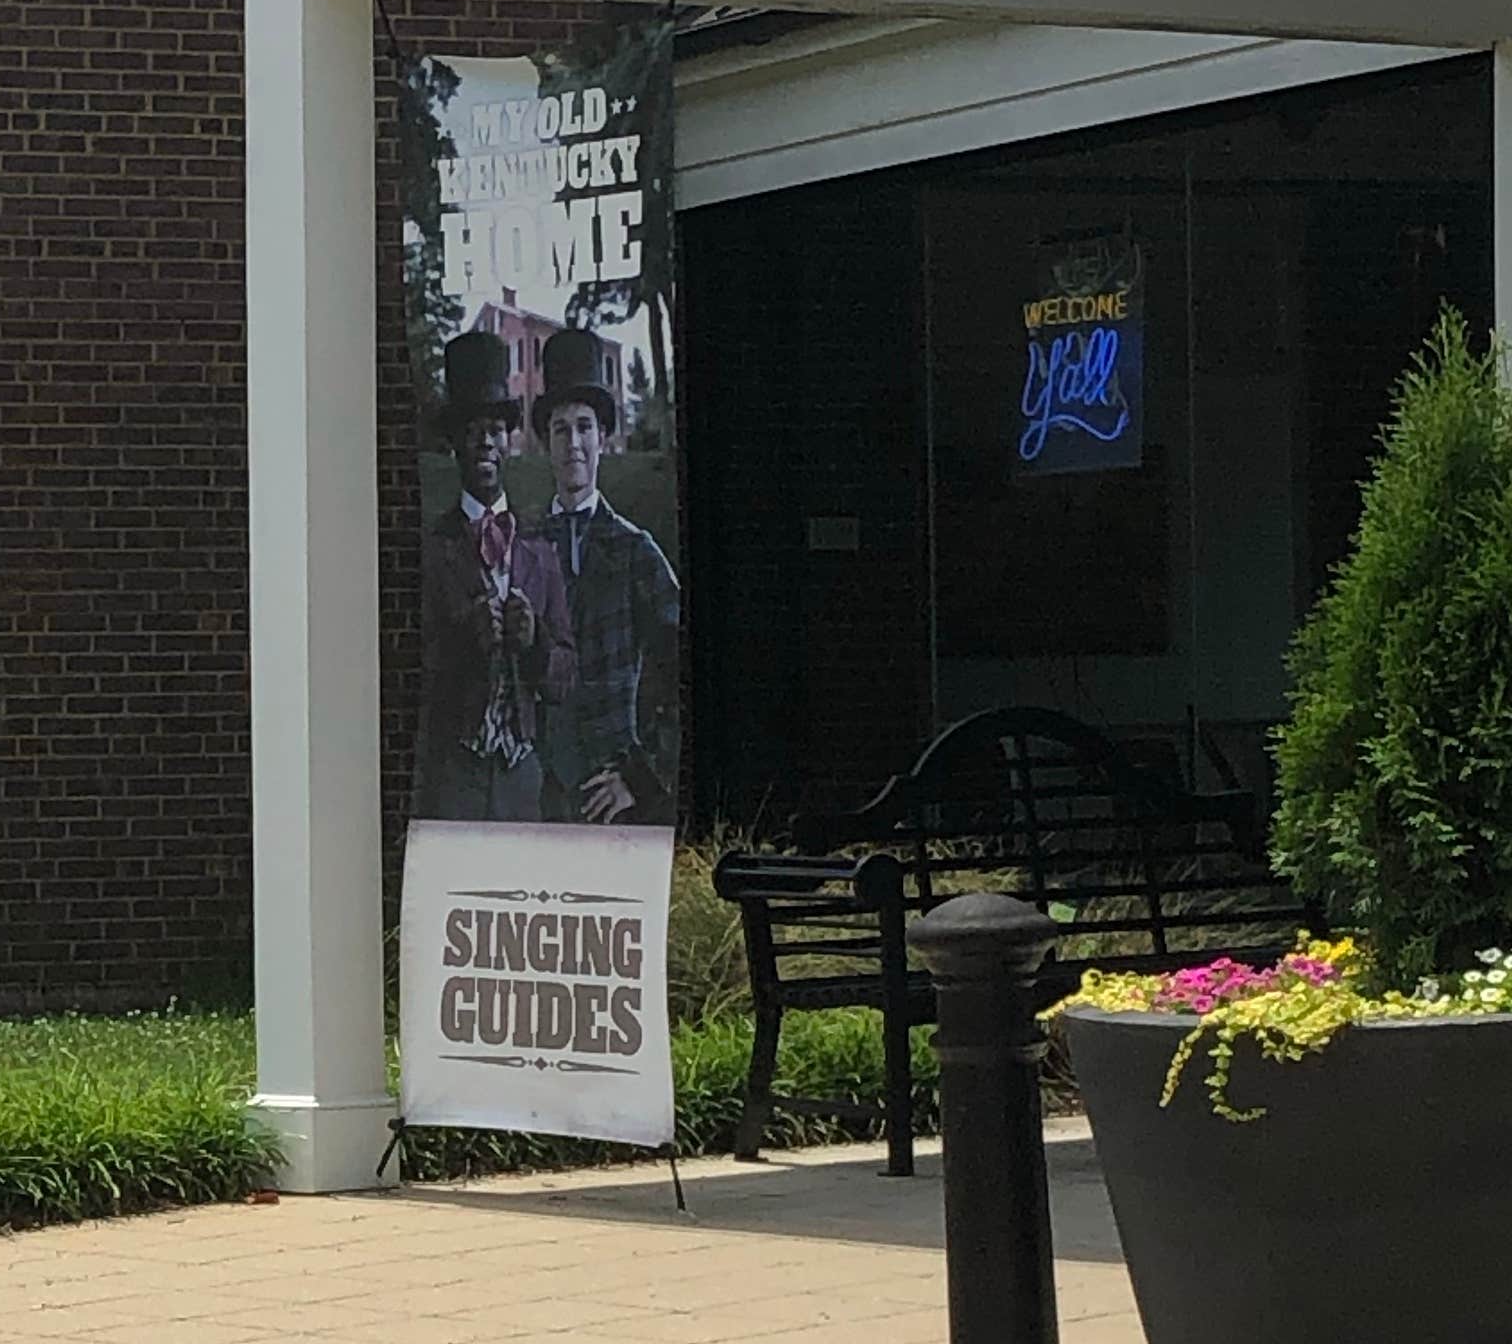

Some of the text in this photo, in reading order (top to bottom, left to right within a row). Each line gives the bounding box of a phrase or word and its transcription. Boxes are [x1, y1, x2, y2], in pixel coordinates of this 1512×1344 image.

[471, 87, 607, 149] MY OLD
[437, 136, 641, 205] KENTUCKY
[440, 191, 644, 295] HOME
[1024, 291, 1129, 328] WELCOME
[443, 908, 643, 980] SINGING
[440, 976, 643, 1056] GUIDES
